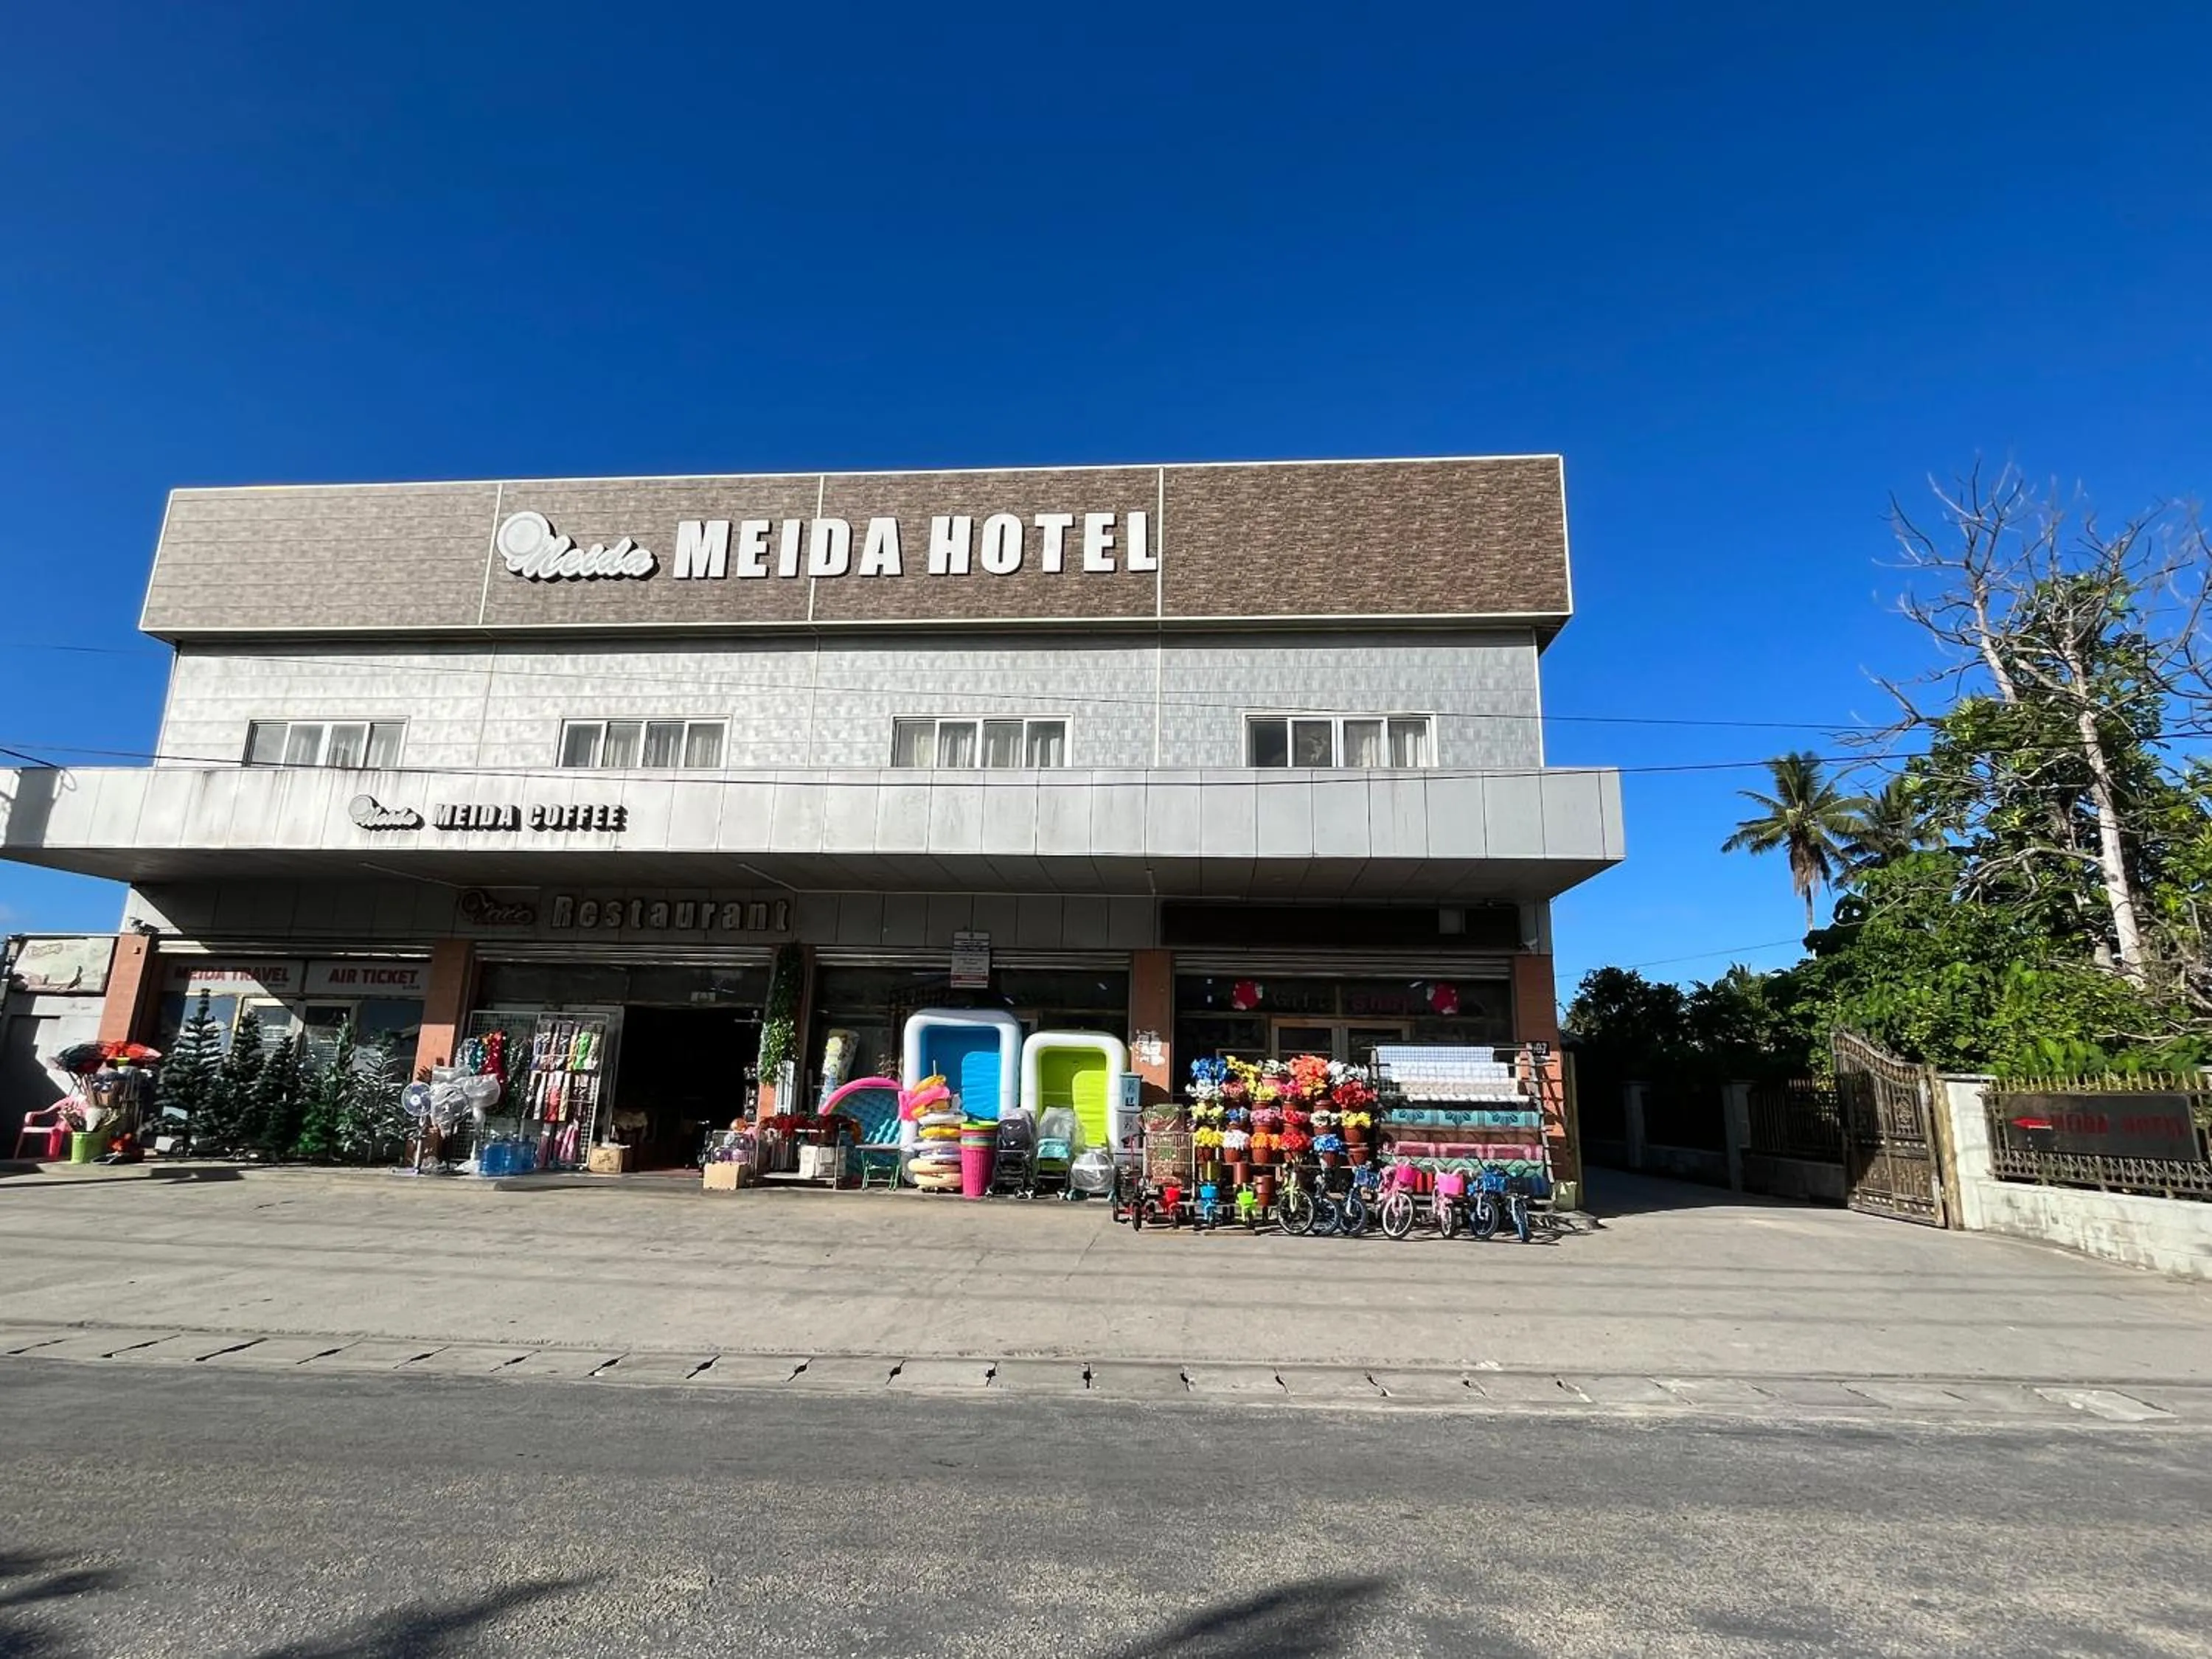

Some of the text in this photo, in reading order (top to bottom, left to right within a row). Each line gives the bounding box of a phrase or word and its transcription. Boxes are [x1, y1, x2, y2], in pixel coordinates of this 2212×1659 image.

[500, 524, 655, 579] Meida
[673, 512, 1158, 578] MEIDA HOTEL
[433, 804, 627, 831] MEIDA COFFEE
[551, 894, 790, 932] Restaurant
[175, 966, 291, 982] MEIDA TRAVEL
[328, 968, 419, 984] AIR TICKET
